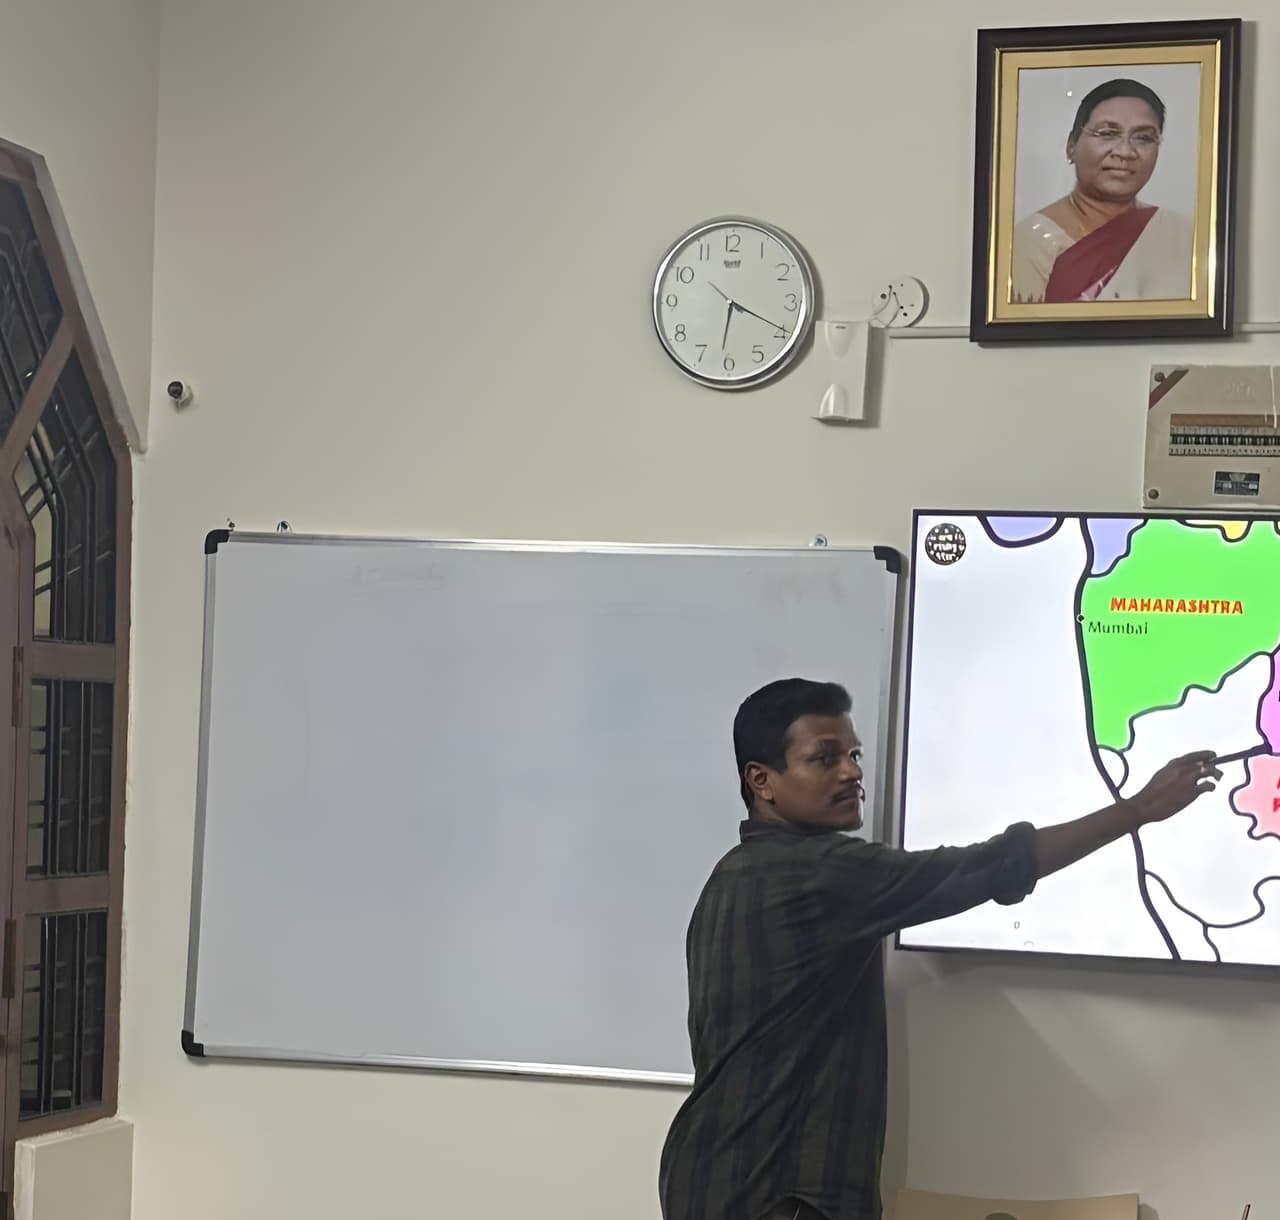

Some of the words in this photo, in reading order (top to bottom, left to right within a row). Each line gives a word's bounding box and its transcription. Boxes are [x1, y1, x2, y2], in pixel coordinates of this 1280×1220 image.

[699, 243, 710, 261] 11
[725, 234, 741, 253] 12
[675, 266, 694, 283] 10
[776, 263, 790, 281] 2
[665, 293, 677, 311] 9
[784, 294, 797, 311] 3
[674, 324, 686, 342] 8
[773, 324, 786, 340] 4
[695, 345, 707, 362] 7
[724, 353, 735, 370] 6
[752, 345, 764, 363] 5
[1110, 597, 1243, 615] MAHARASHTRA
[1088, 621, 1148, 635] Mumbai
